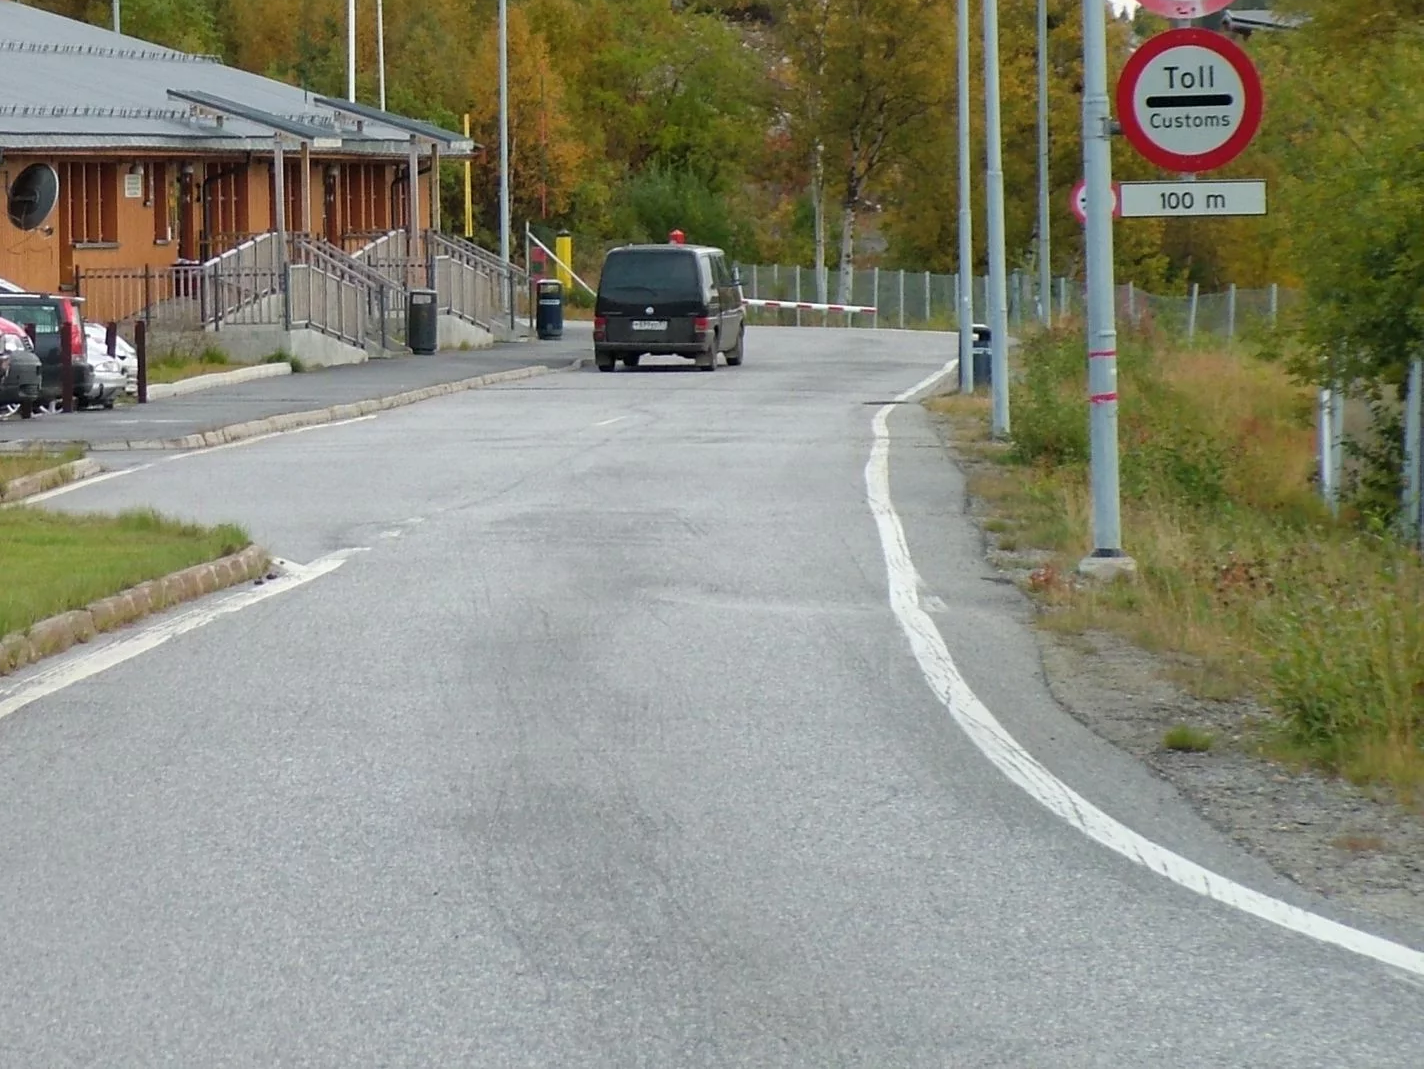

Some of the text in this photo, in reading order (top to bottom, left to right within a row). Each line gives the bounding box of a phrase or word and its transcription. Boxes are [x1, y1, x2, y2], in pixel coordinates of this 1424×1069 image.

[1164, 66, 1213, 88] Toll
[1150, 112, 1230, 129] Customs
[1160, 192, 1225, 210] 100 m
